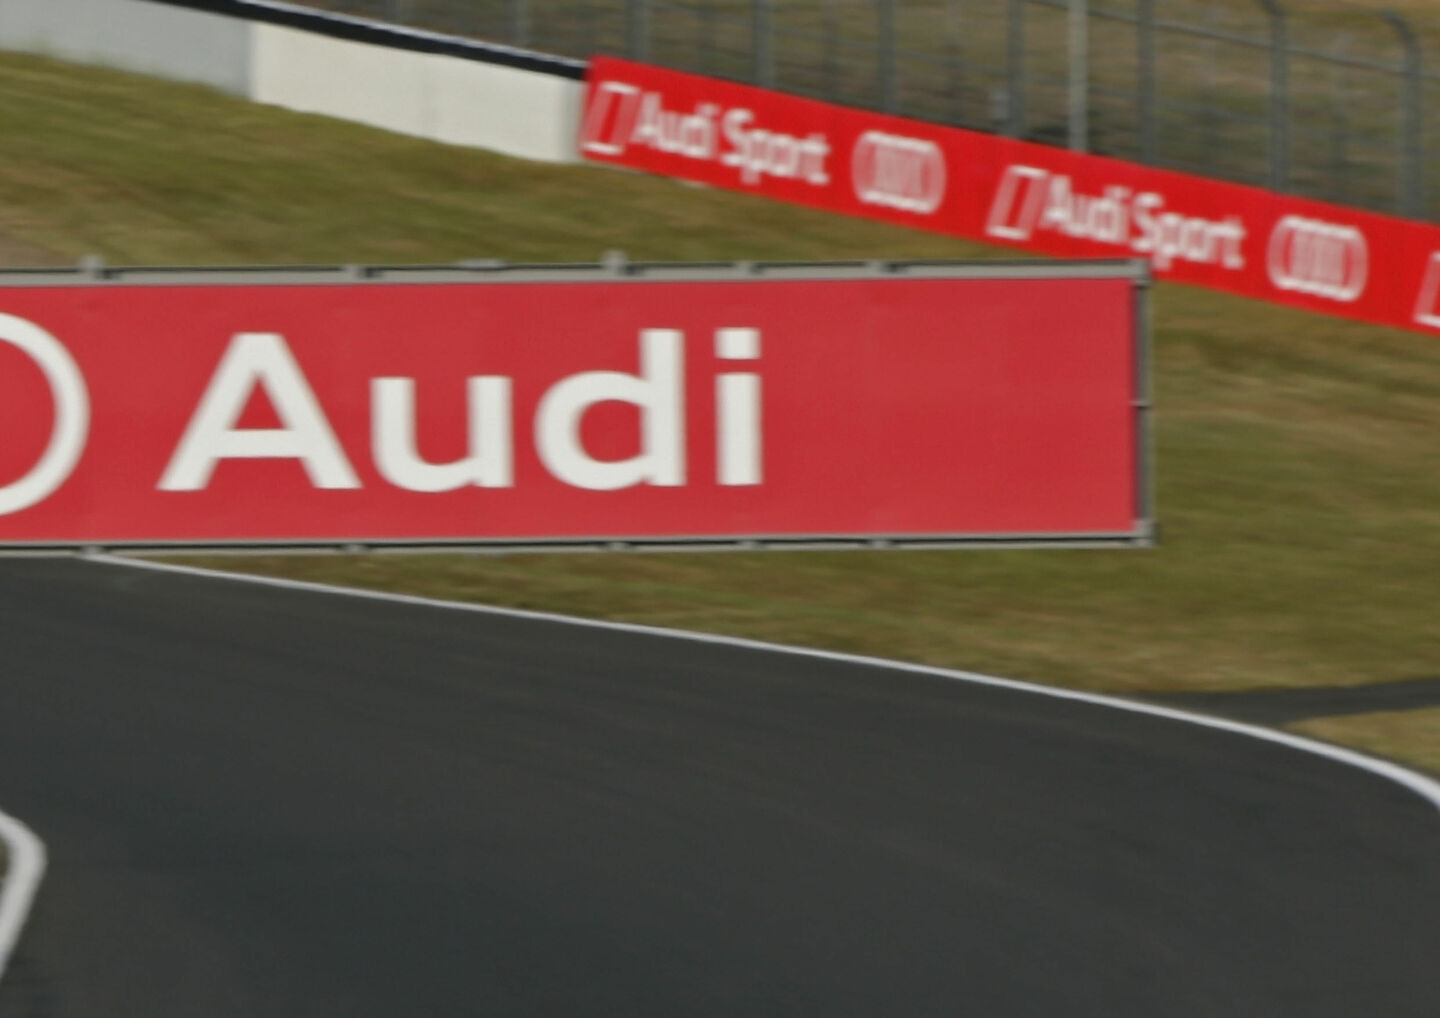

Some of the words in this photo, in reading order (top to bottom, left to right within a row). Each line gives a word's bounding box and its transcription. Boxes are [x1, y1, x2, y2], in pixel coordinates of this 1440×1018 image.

[629, 92, 718, 160] Audi
[720, 107, 831, 185] Sport
[1038, 173, 1130, 245] Audi
[1131, 193, 1246, 271] Sport
[156, 327, 764, 492] Audi
